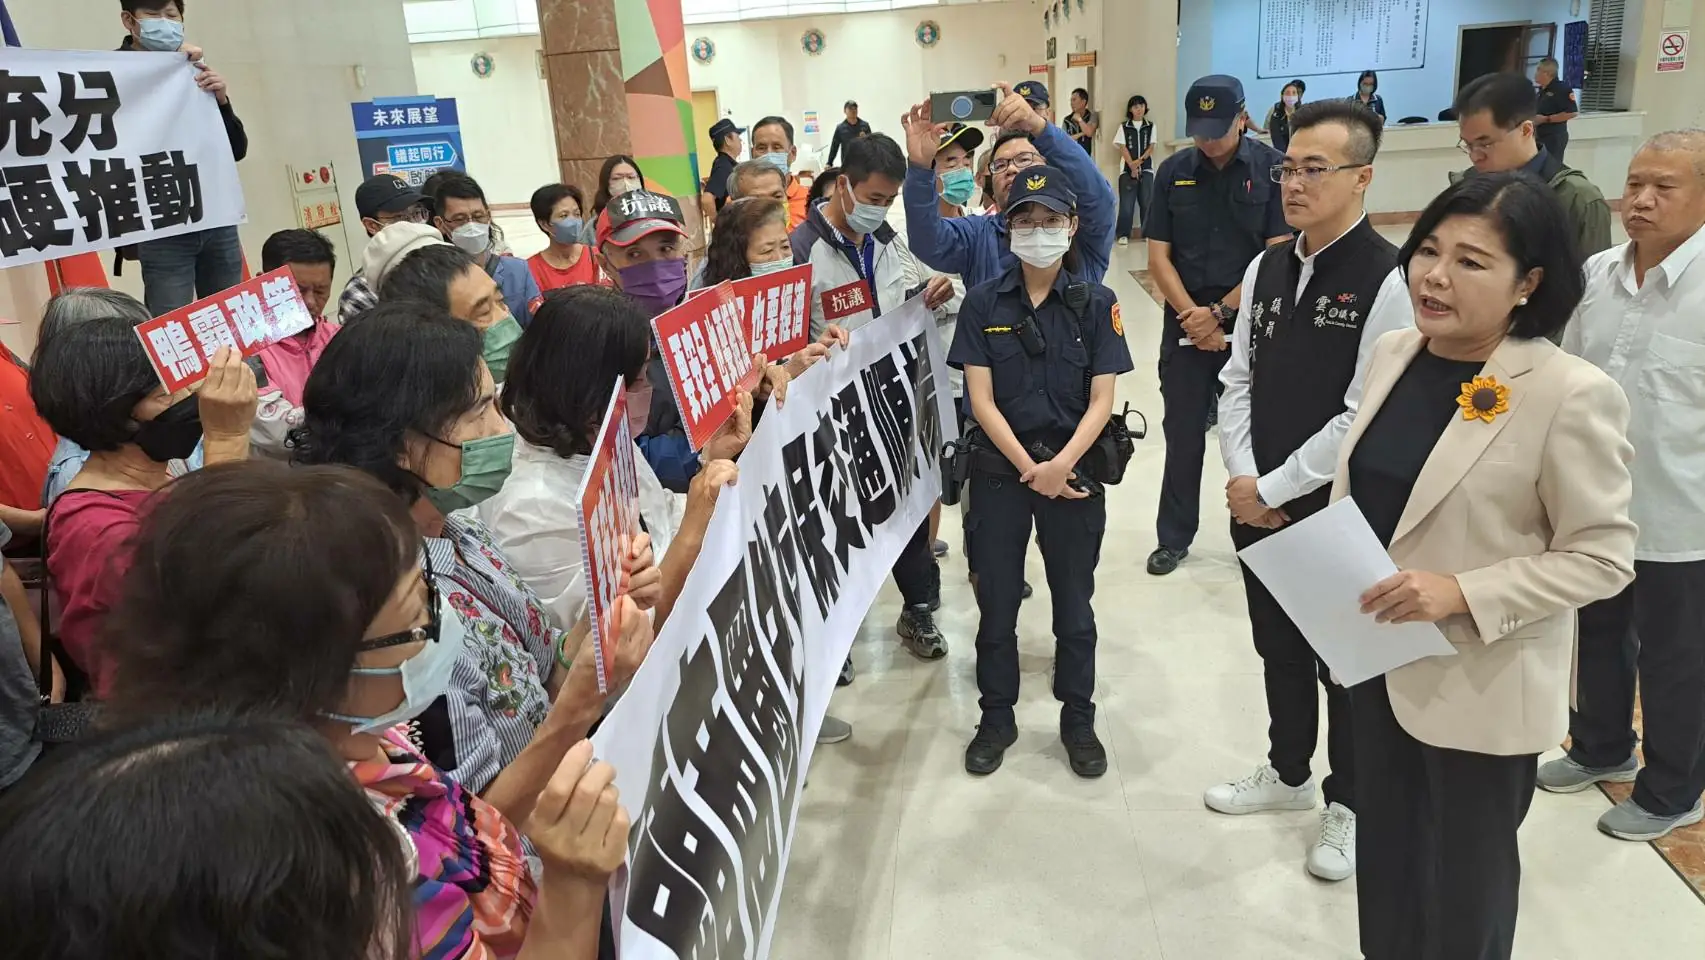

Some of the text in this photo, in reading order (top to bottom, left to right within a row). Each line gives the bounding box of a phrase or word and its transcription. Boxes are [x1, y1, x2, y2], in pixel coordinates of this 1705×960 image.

[0, 69, 121, 157] 充分
[372, 106, 440, 127] 未來展望
[620, 193, 674, 216] 抗議
[751, 279, 807, 355] 也要經濟
[831, 287, 866, 313] 抗議
[1264, 297, 1283, 339] 議員
[147, 275, 301, 382] 鴨霸政策
